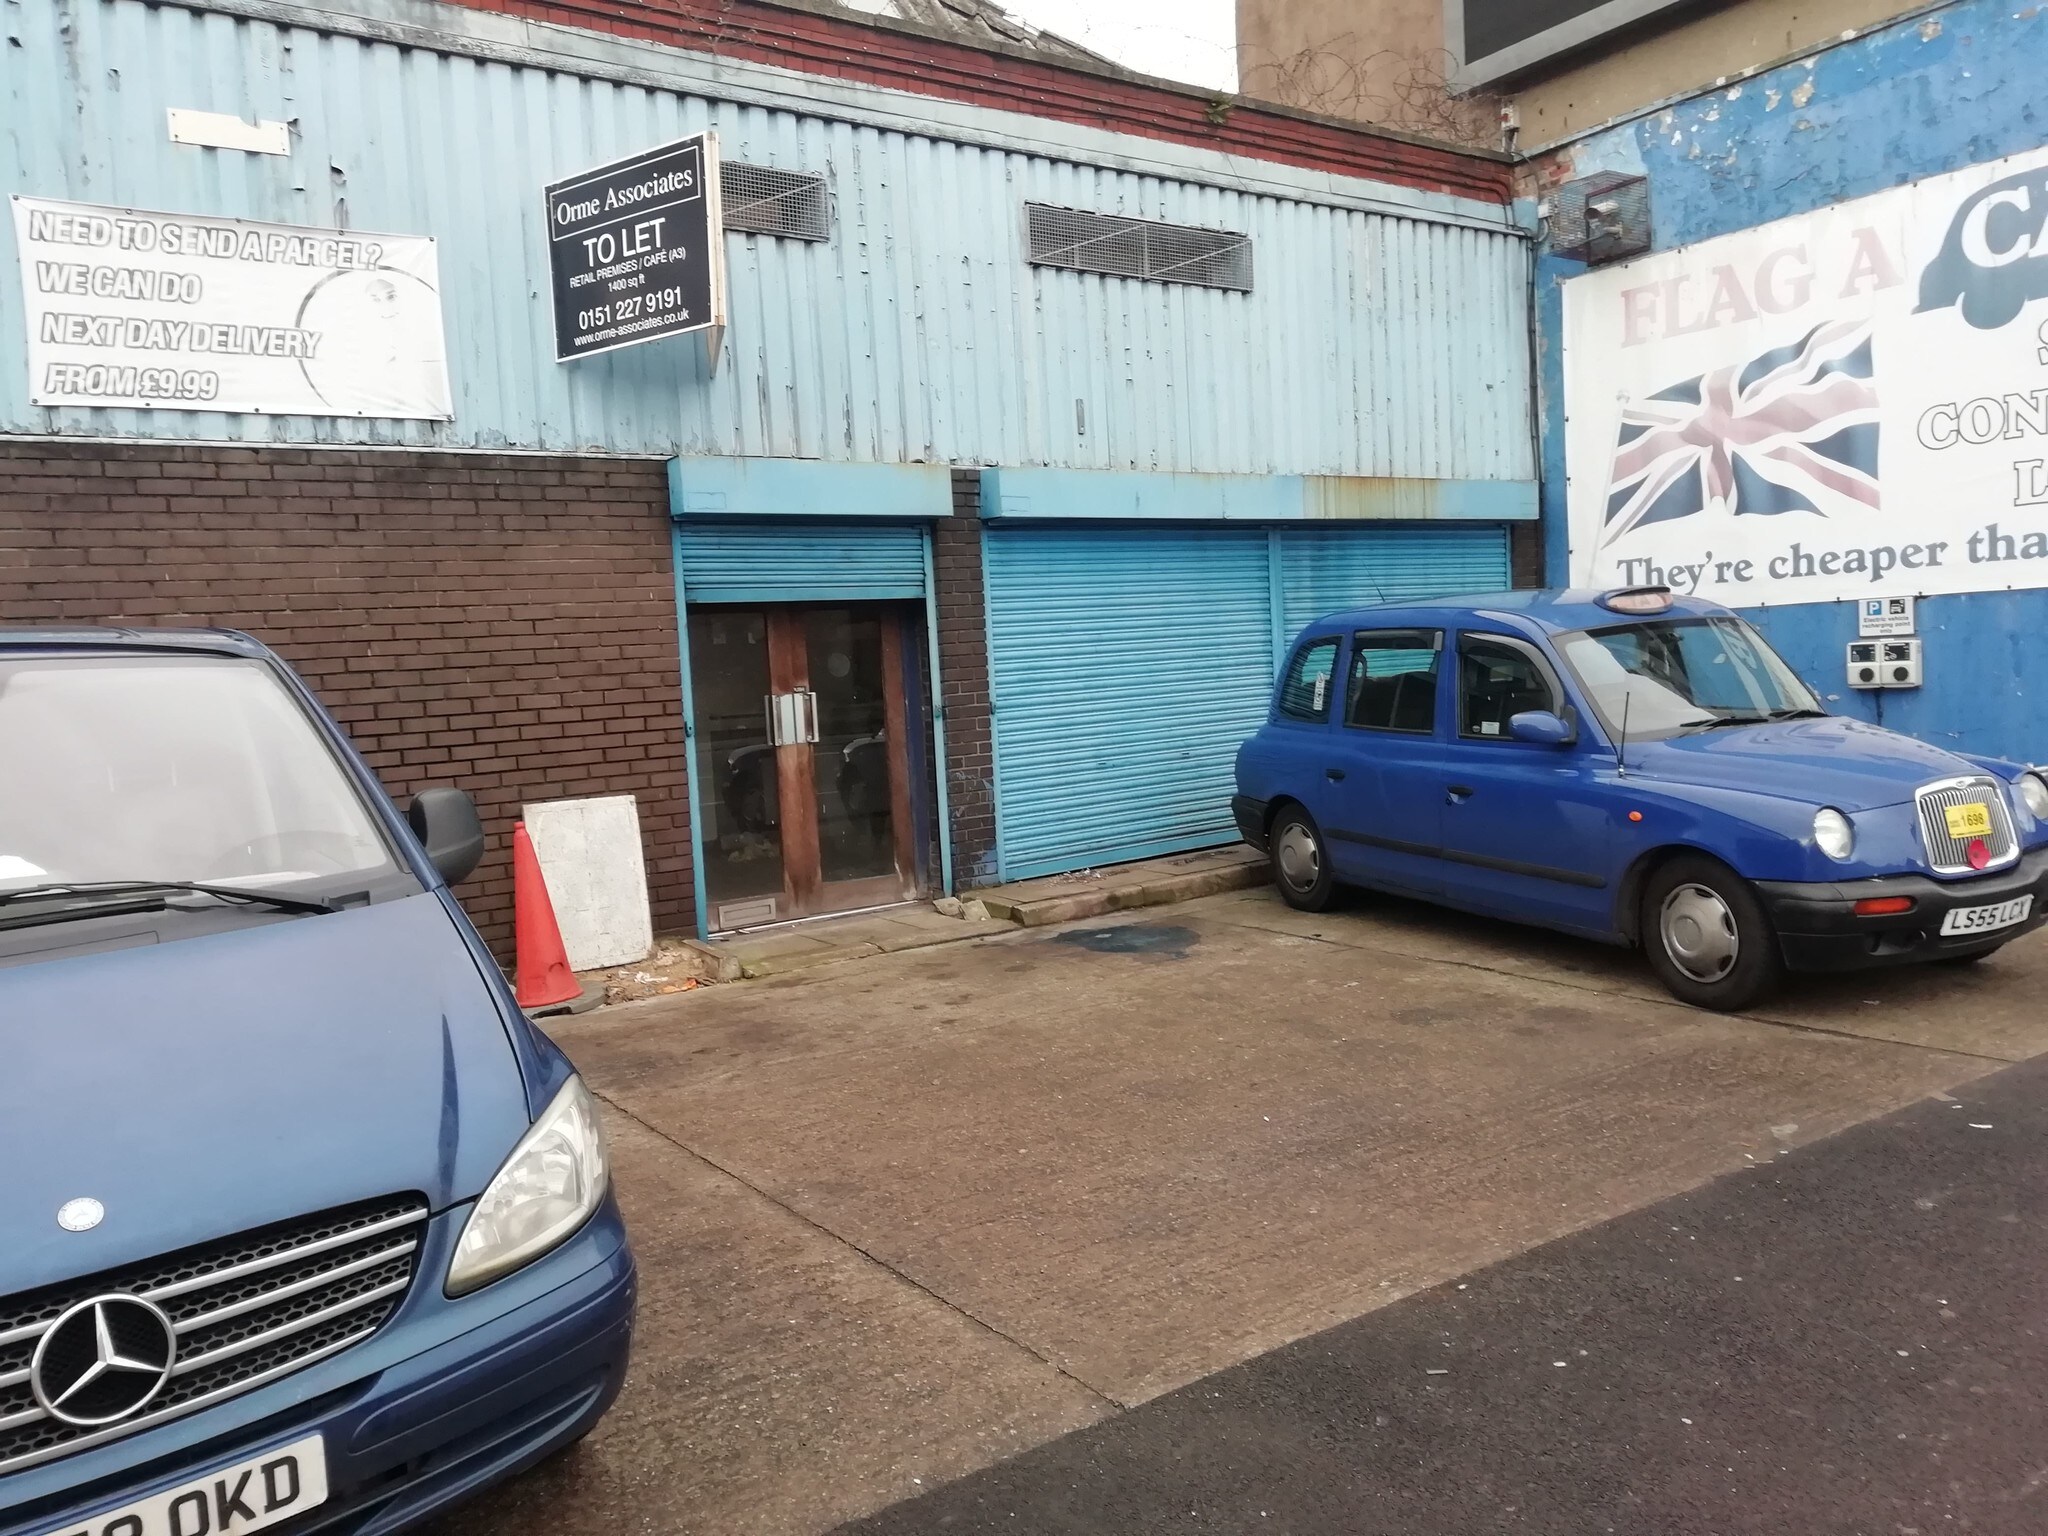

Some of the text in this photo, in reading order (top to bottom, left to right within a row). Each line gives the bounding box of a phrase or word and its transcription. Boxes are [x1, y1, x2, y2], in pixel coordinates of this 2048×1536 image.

[555, 168, 694, 225] Orme Associates
[30, 210, 384, 271] NEED TO SEND A PARCEL?
[582, 217, 666, 267] TO LET
[37, 261, 203, 303] WE CAN DO
[569, 272, 597, 288] RETAIL
[596, 259, 638, 281] PREMISES
[608, 273, 646, 292] 1400 sq ft
[1620, 225, 1904, 348] FLAG A
[573, 307, 690, 347] www.orme-associates.co.uk
[578, 286, 682, 330] 0151 227 9191
[42, 312, 323, 359] NEXT DAY DELIVERY
[45, 362, 219, 401] FROM £9.99
[1616, 550, 1754, 596] They're
[1768, 541, 1950, 584] cheaper
[1950, 907, 2000, 930] LS55
[168, 1455, 300, 1536] OKD
